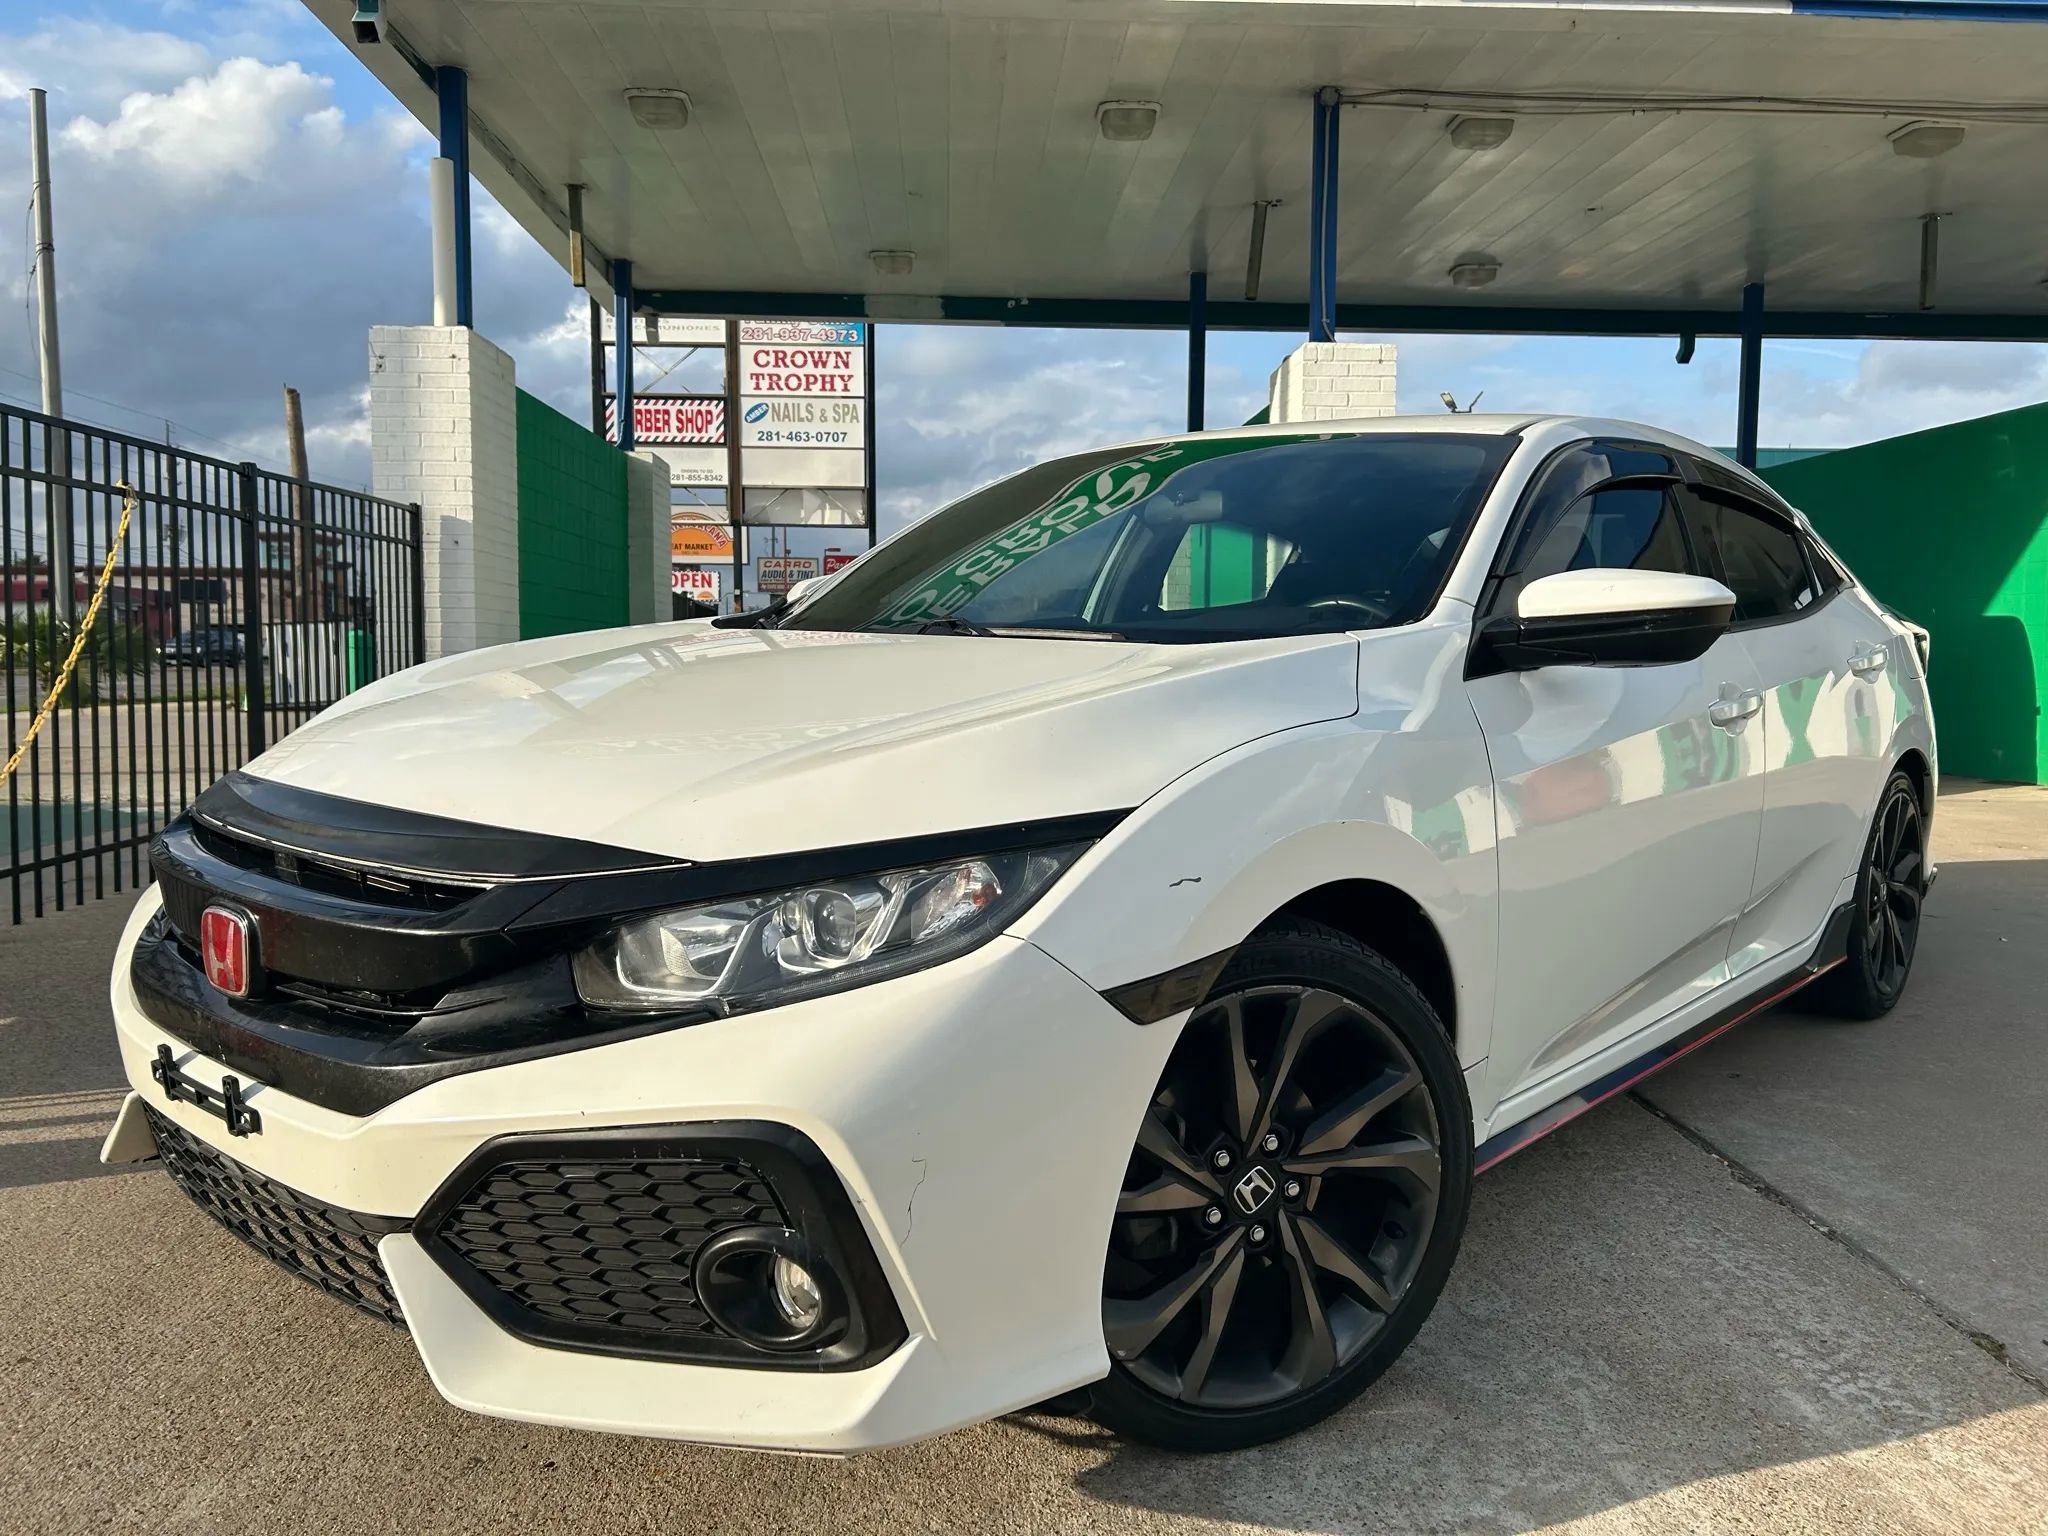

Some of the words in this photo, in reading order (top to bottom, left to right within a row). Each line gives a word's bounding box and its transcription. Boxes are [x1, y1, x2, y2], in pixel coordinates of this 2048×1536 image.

[742, 326, 858, 342] 281-937-4973
[753, 349, 851, 369] CROWN
[750, 373, 854, 392] TROPHY
[746, 404, 768, 423] AMBER
[771, 402, 814, 423] NAILS
[819, 408, 828, 423] &
[832, 403, 860, 424] SPA
[634, 408, 671, 433] RBER
[676, 408, 714, 434] SHOP
[757, 430, 848, 442] 281-463-0707
[671, 474, 723, 482] 281-855-8342
[685, 543, 713, 551] MARKET
[764, 560, 812, 569] CARRO
[672, 573, 712, 588] OPEN
[788, 570, 795, 579] &
[797, 570, 815, 579] TINT
